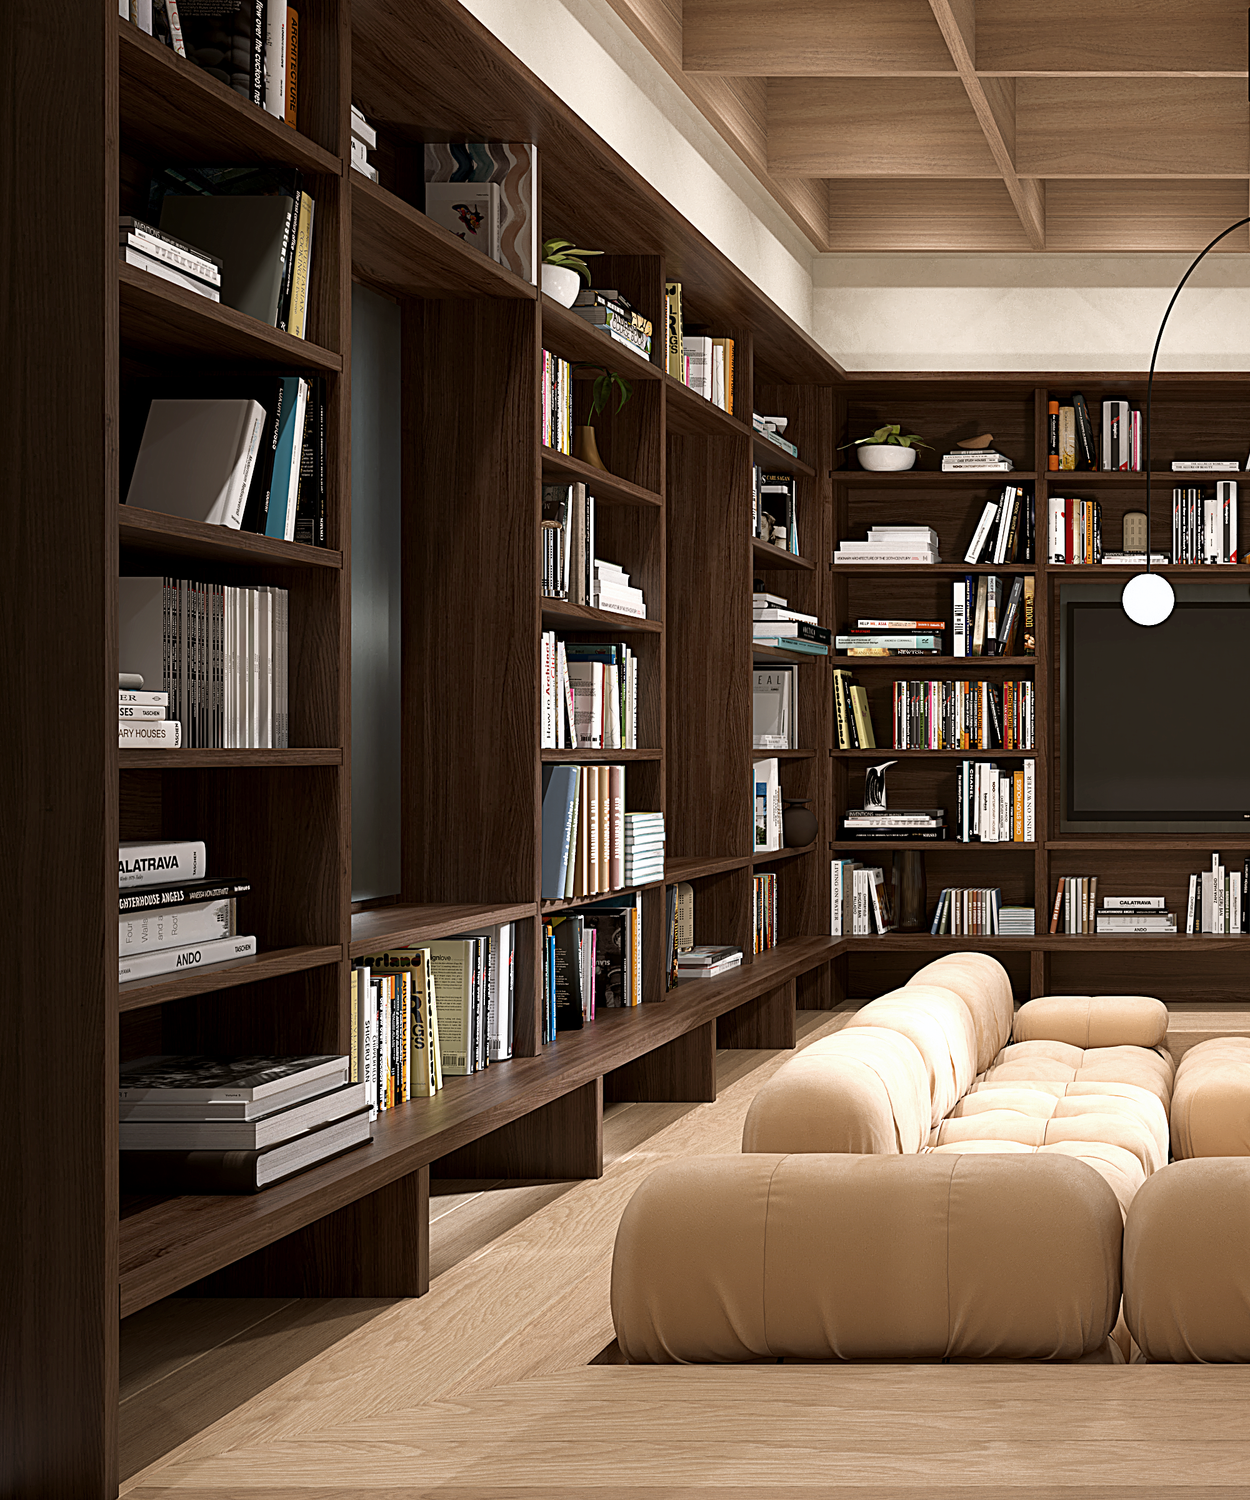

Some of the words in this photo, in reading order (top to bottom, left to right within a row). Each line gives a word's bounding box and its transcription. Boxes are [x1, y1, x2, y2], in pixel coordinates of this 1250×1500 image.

[255, 19, 263, 38] over
[255, 39, 263, 52] the
[254, 53, 263, 88] cuckoo's
[289, 17, 298, 112] ARCHITECTURE
[297, 230, 305, 276] COOKING
[272, 418, 281, 450] HOUSES
[1025, 606, 1033, 628] moon
[758, 675, 781, 685] EAL
[119, 707, 134, 716] SES
[545, 699, 551, 710] to
[119, 729, 134, 738] ARY
[136, 729, 167, 739] HOUSES
[1026, 802, 1032, 813] ON
[119, 856, 179, 873] ALATRAVA
[119, 894, 160, 910] GHTERHOUSE
[161, 890, 184, 904] ANGELS
[834, 887, 839, 898] ON
[235, 944, 252, 953] TASCHEN
[176, 951, 202, 967] ANDO
[354, 953, 422, 967] derland
